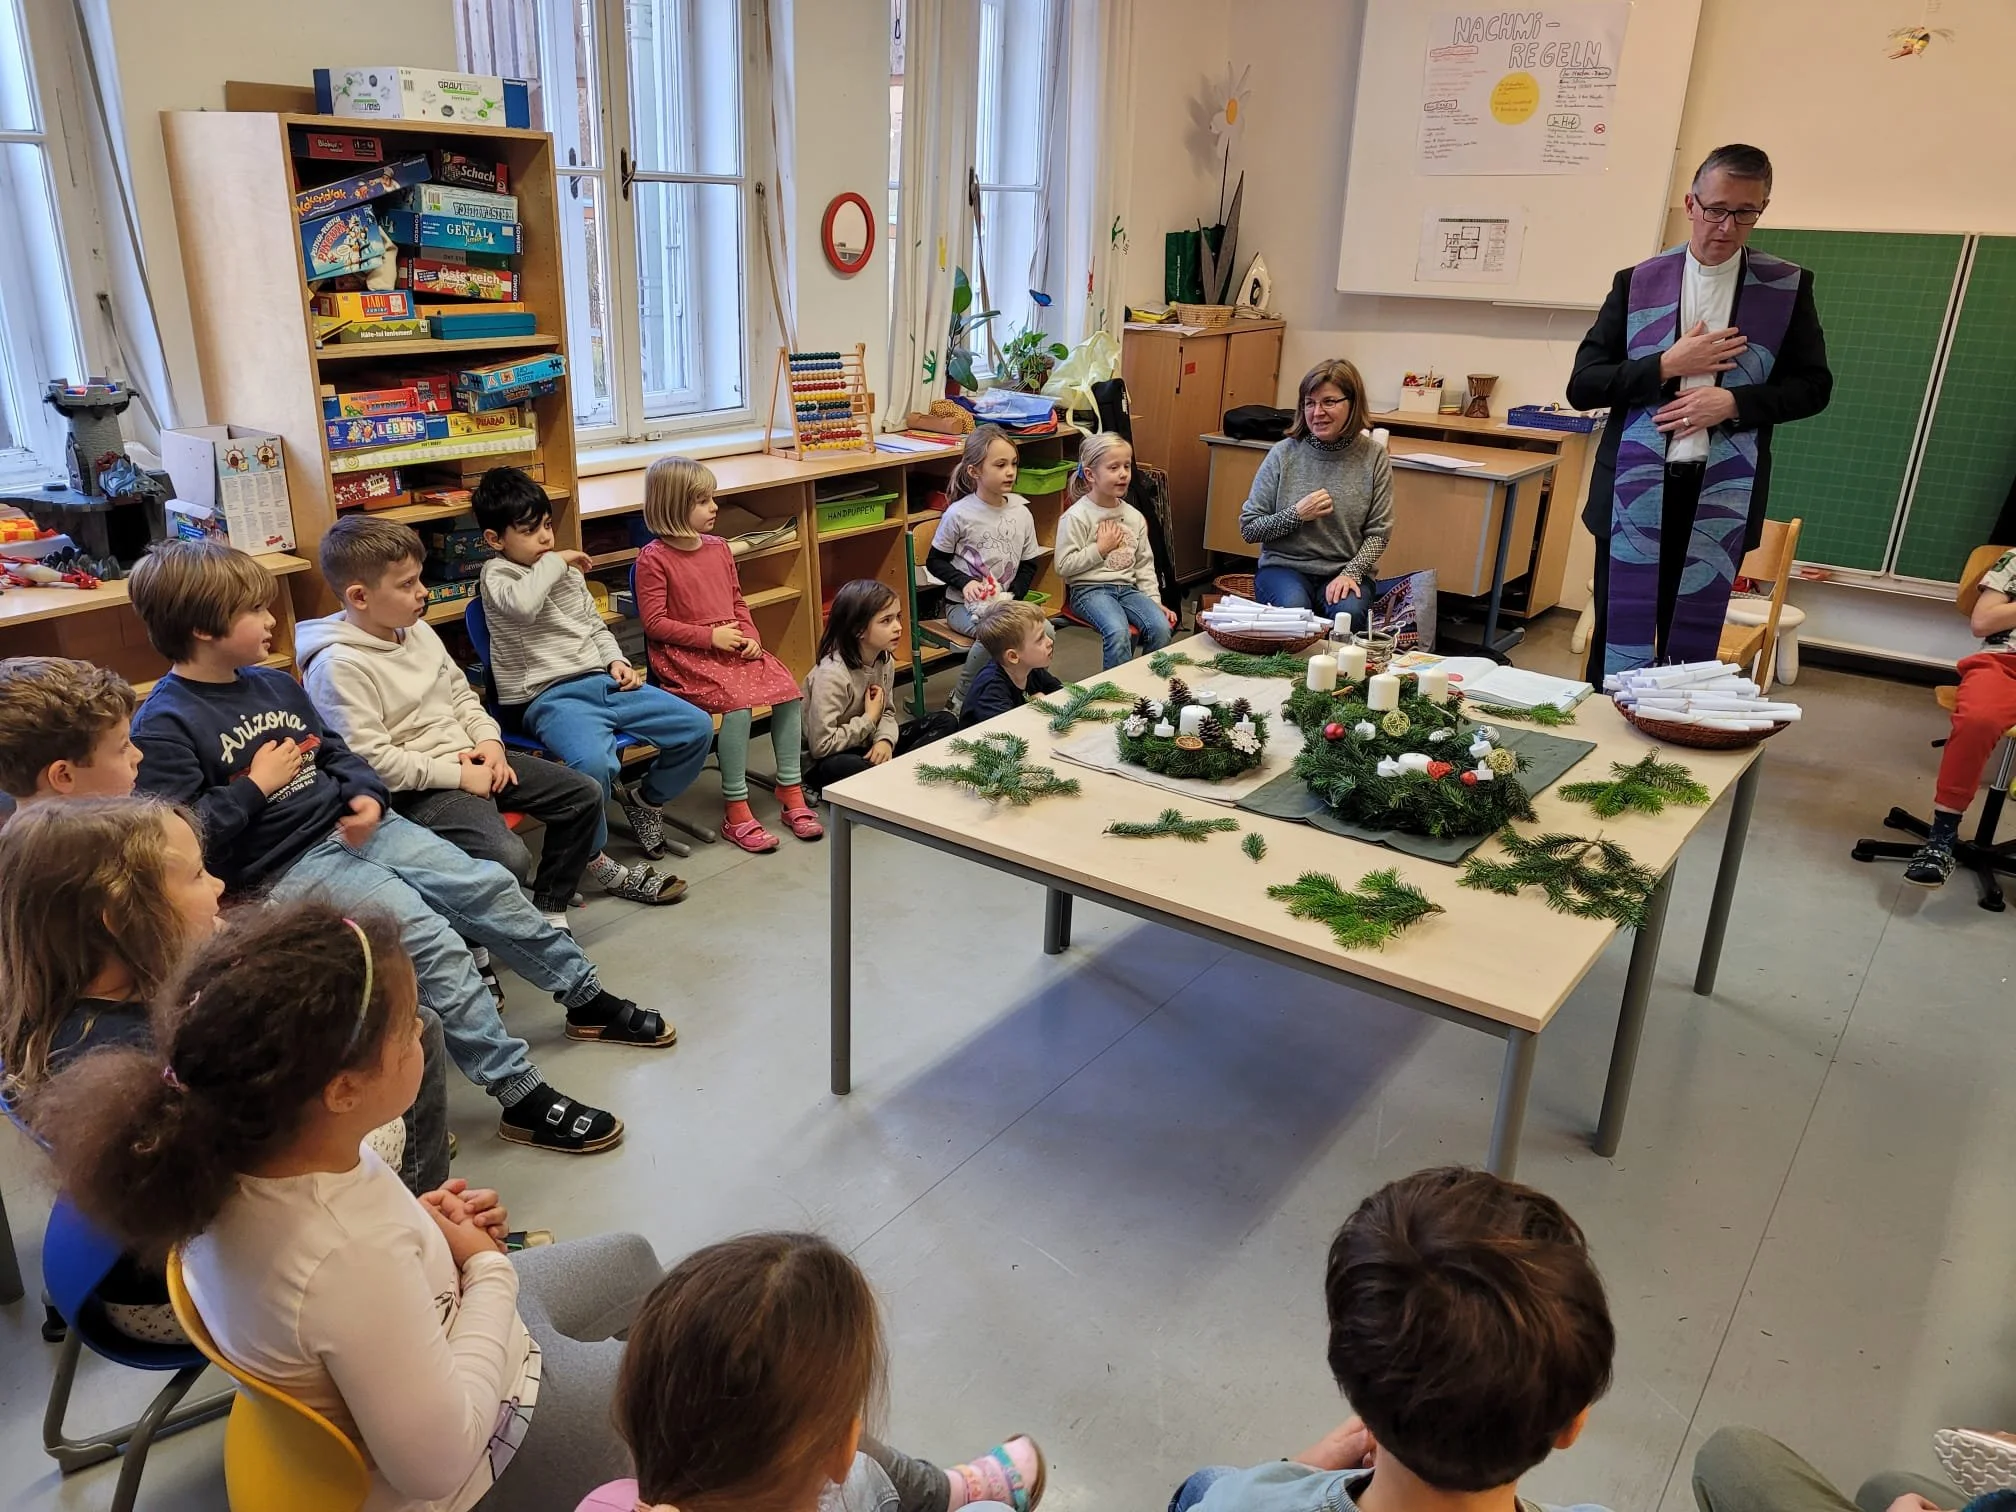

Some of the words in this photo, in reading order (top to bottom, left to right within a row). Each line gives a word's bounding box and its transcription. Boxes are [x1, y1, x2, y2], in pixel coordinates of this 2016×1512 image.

[1508, 40, 1603, 69] REGELN
[460, 164, 496, 183] Schach
[452, 201, 514, 222] KRISTALLICA
[440, 264, 500, 285] Österreich
[366, 295, 386, 308] TABU
[377, 420, 425, 436] LEBENS
[827, 505, 876, 521] HANDPUPPEN
[219, 709, 308, 765] Arizona
